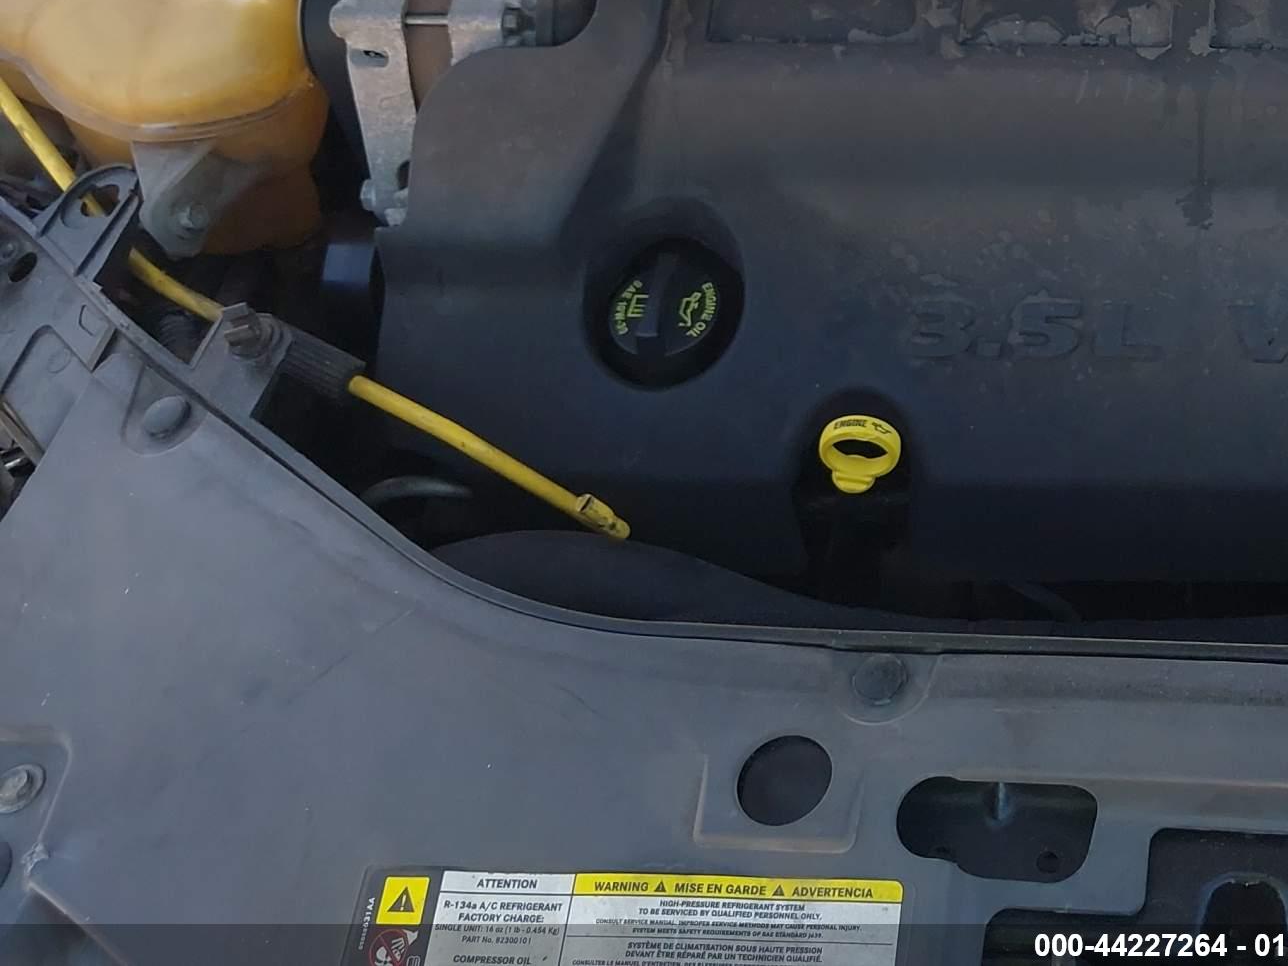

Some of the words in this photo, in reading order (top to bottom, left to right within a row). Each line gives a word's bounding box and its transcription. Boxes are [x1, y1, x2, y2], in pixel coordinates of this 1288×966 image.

[702, 282, 717, 321] ENGINE
[685, 321, 706, 337] OIL
[908, 296, 1163, 362] 3.5L
[834, 418, 868, 430] ENGINE
[477, 879, 538, 889] ATTENTION
[594, 881, 649, 892] WARNING
[674, 883, 703, 893] MISE
[706, 884, 722, 894] EN
[725, 885, 766, 896] GARDE
[792, 886, 873, 898] ADVERTENCIA
[443, 900, 477, 910] R-134a
[479, 901, 498, 911] A/C
[499, 901, 563, 912] REFRIGERANT
[659, 900, 720, 908] HIGH-PRESSURE
[721, 901, 775, 911] REFRIGERANT
[776, 904, 805, 912] SYSTEM
[458, 912, 502, 922] FACTORY
[503, 914, 544, 923] CHARGE:
[711, 910, 753, 918] QUALIFIED
[754, 912, 799, 920] PERSONNEL
[434, 924, 461, 932] SINGLE
[463, 924, 483, 932] UNIT:
[485, 925, 494, 933] 16
[525, 926, 546, 934] 0.454
[461, 935, 481, 943] PART
[482, 936, 494, 944] No.
[627, 940, 662, 950] SYSTÈME
[663, 942, 674, 950] DE
[675, 942, 734, 952] CLIMATISATION
[735, 944, 757, 953] SOUS
[758, 945, 785, 953] HAUTE
[786, 946, 823, 954] PRESSION
[453, 955, 515, 965] COMPRESSOR
[516, 956, 532, 966] OIL
[625, 950, 655, 958] DEVANT
[656, 949, 676, 959] ÊTRE
[676, 950, 706, 960] RÉPARÉ
[707, 952, 723, 960] PAR
[724, 953, 737, 961] UN
[738, 953, 785, 962] TECHNICIEN
